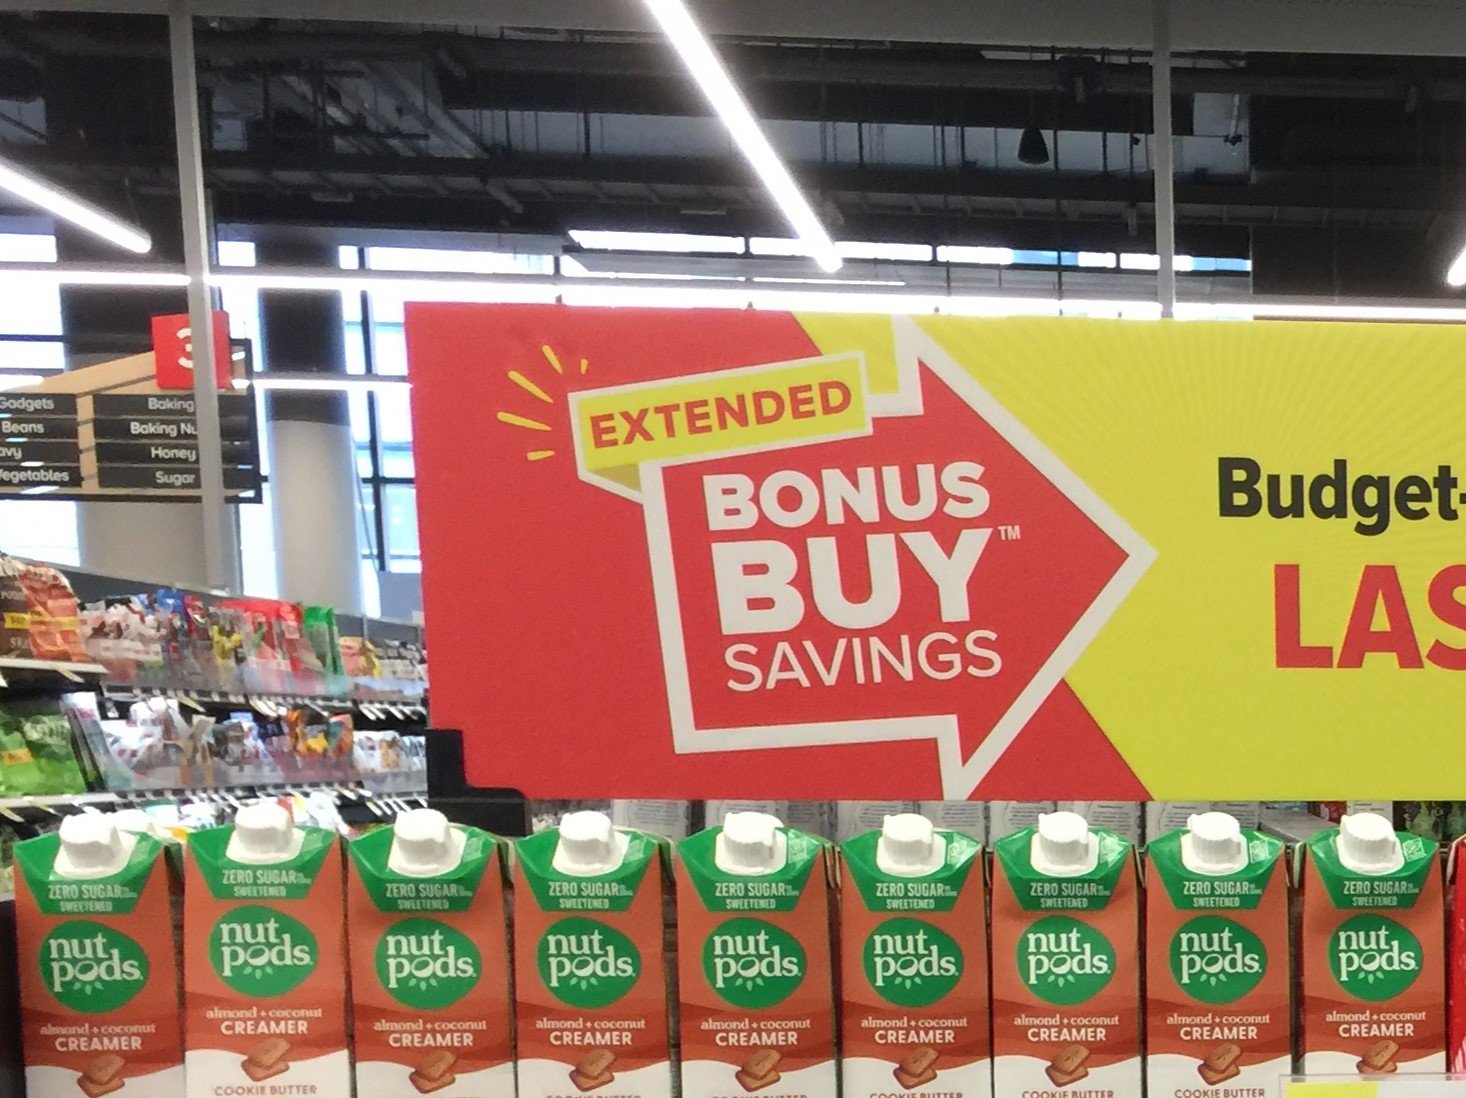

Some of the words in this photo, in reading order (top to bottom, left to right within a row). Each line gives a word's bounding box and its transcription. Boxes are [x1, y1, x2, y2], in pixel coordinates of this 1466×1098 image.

[148, 398, 194, 412] Baking
[589, 379, 851, 449] EXTENDED
[2, 421, 44, 433] Beans
[130, 422, 177, 437] Baking
[151, 447, 196, 461] Honey
[156, 471, 195, 485] Sugar
[702, 461, 990, 531] BONUS
[711, 526, 992, 635] BUY
[724, 630, 1002, 692] SAVINGS
[715, 882, 744, 896] ZERO
[748, 882, 787, 897] SUGAR
[220, 918, 279, 944] nut
[547, 930, 603, 955] nut
[713, 930, 770, 955] nut
[1028, 928, 1081, 952] nut
[1179, 927, 1232, 952] nut
[49, 932, 107, 958] nut
[221, 933, 312, 977] pods
[51, 946, 143, 993] pods
[548, 945, 635, 988] pods
[715, 945, 801, 988] pods
[1028, 943, 1110, 984] pods
[1180, 943, 1260, 984] pods
[221, 1021, 308, 1035] CREAMER
[701, 1018, 750, 1030] almond
[760, 1019, 811, 1030] coconut
[1028, 1028, 1106, 1041] CREAMER
[1180, 1027, 1258, 1040] CREAMER
[55, 1037, 141, 1051] CREAMER
[550, 1031, 632, 1046] CREAMER
[715, 1032, 798, 1046] CREAMER
